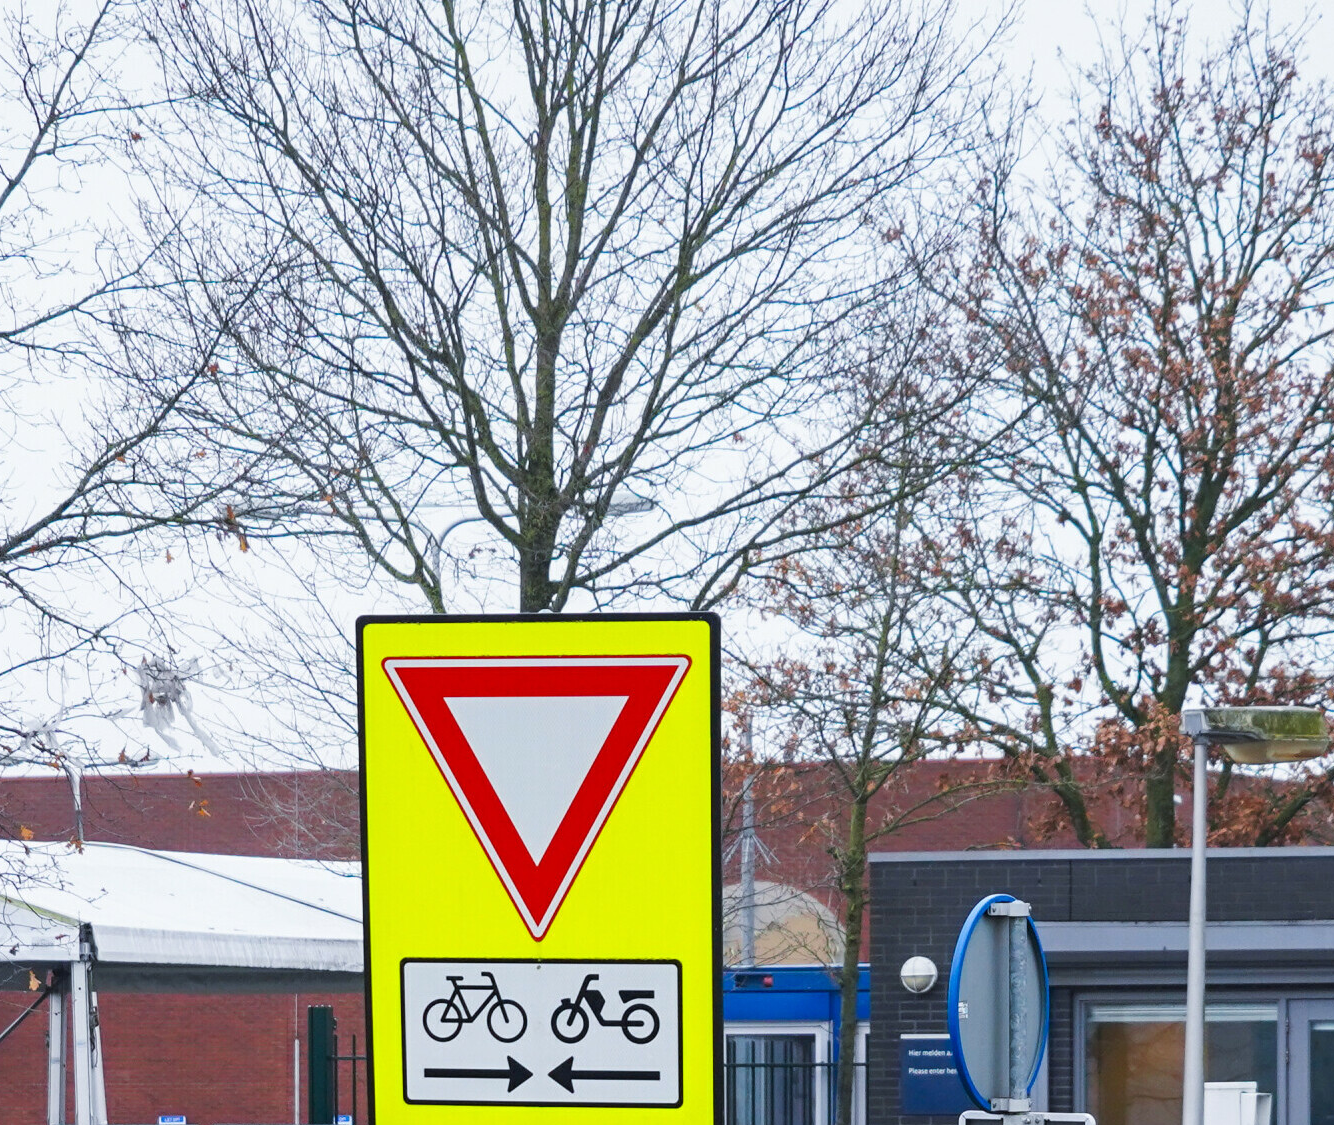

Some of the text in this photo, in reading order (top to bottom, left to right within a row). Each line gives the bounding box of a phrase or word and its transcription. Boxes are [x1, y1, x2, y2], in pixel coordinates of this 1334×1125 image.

[908, 1049, 922, 1057] Hier
[922, 1049, 946, 1057] melden
[908, 1067, 929, 1075] Please
[929, 1067, 946, 1075] enter
